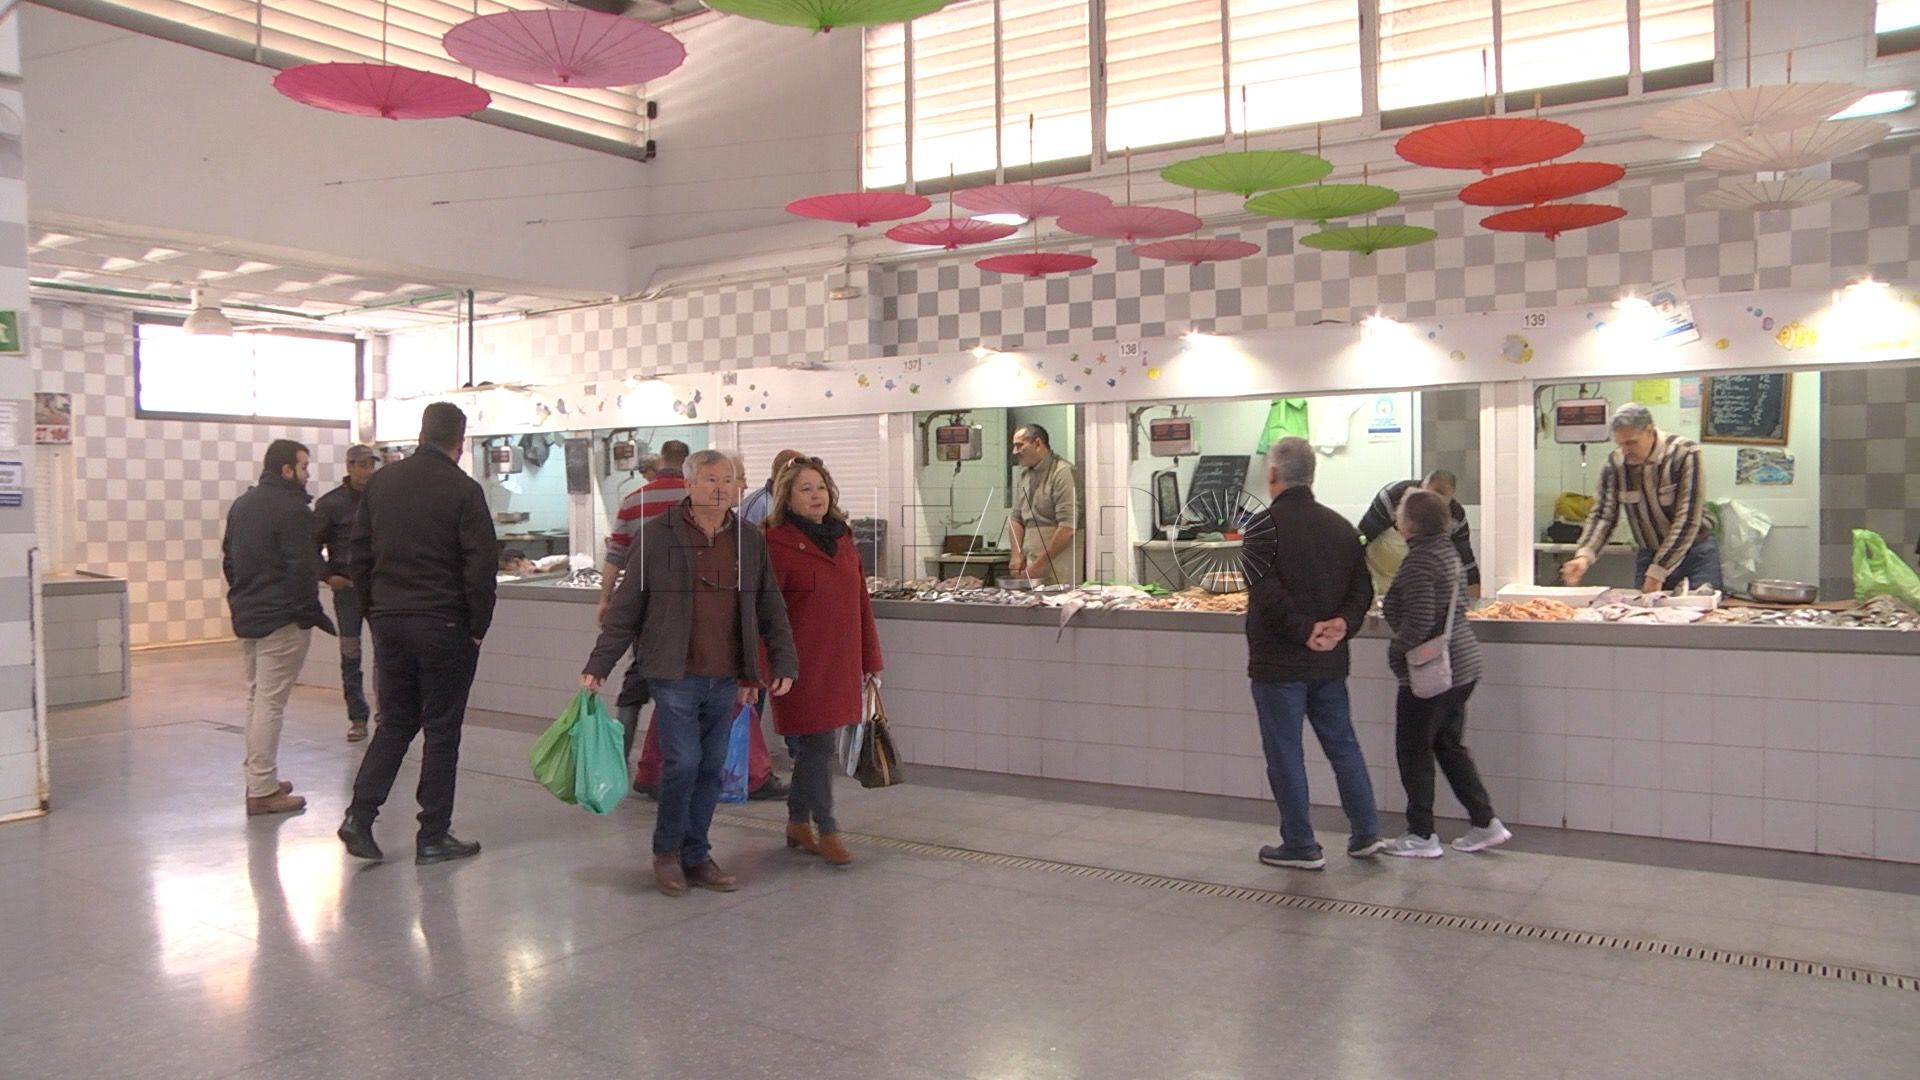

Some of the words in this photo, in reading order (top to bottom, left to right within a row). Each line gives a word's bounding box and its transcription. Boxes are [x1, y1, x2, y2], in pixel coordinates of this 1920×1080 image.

[1524, 313, 1545, 327] 139
[1121, 345, 1140, 358] 138
[903, 359, 918, 371] 137
